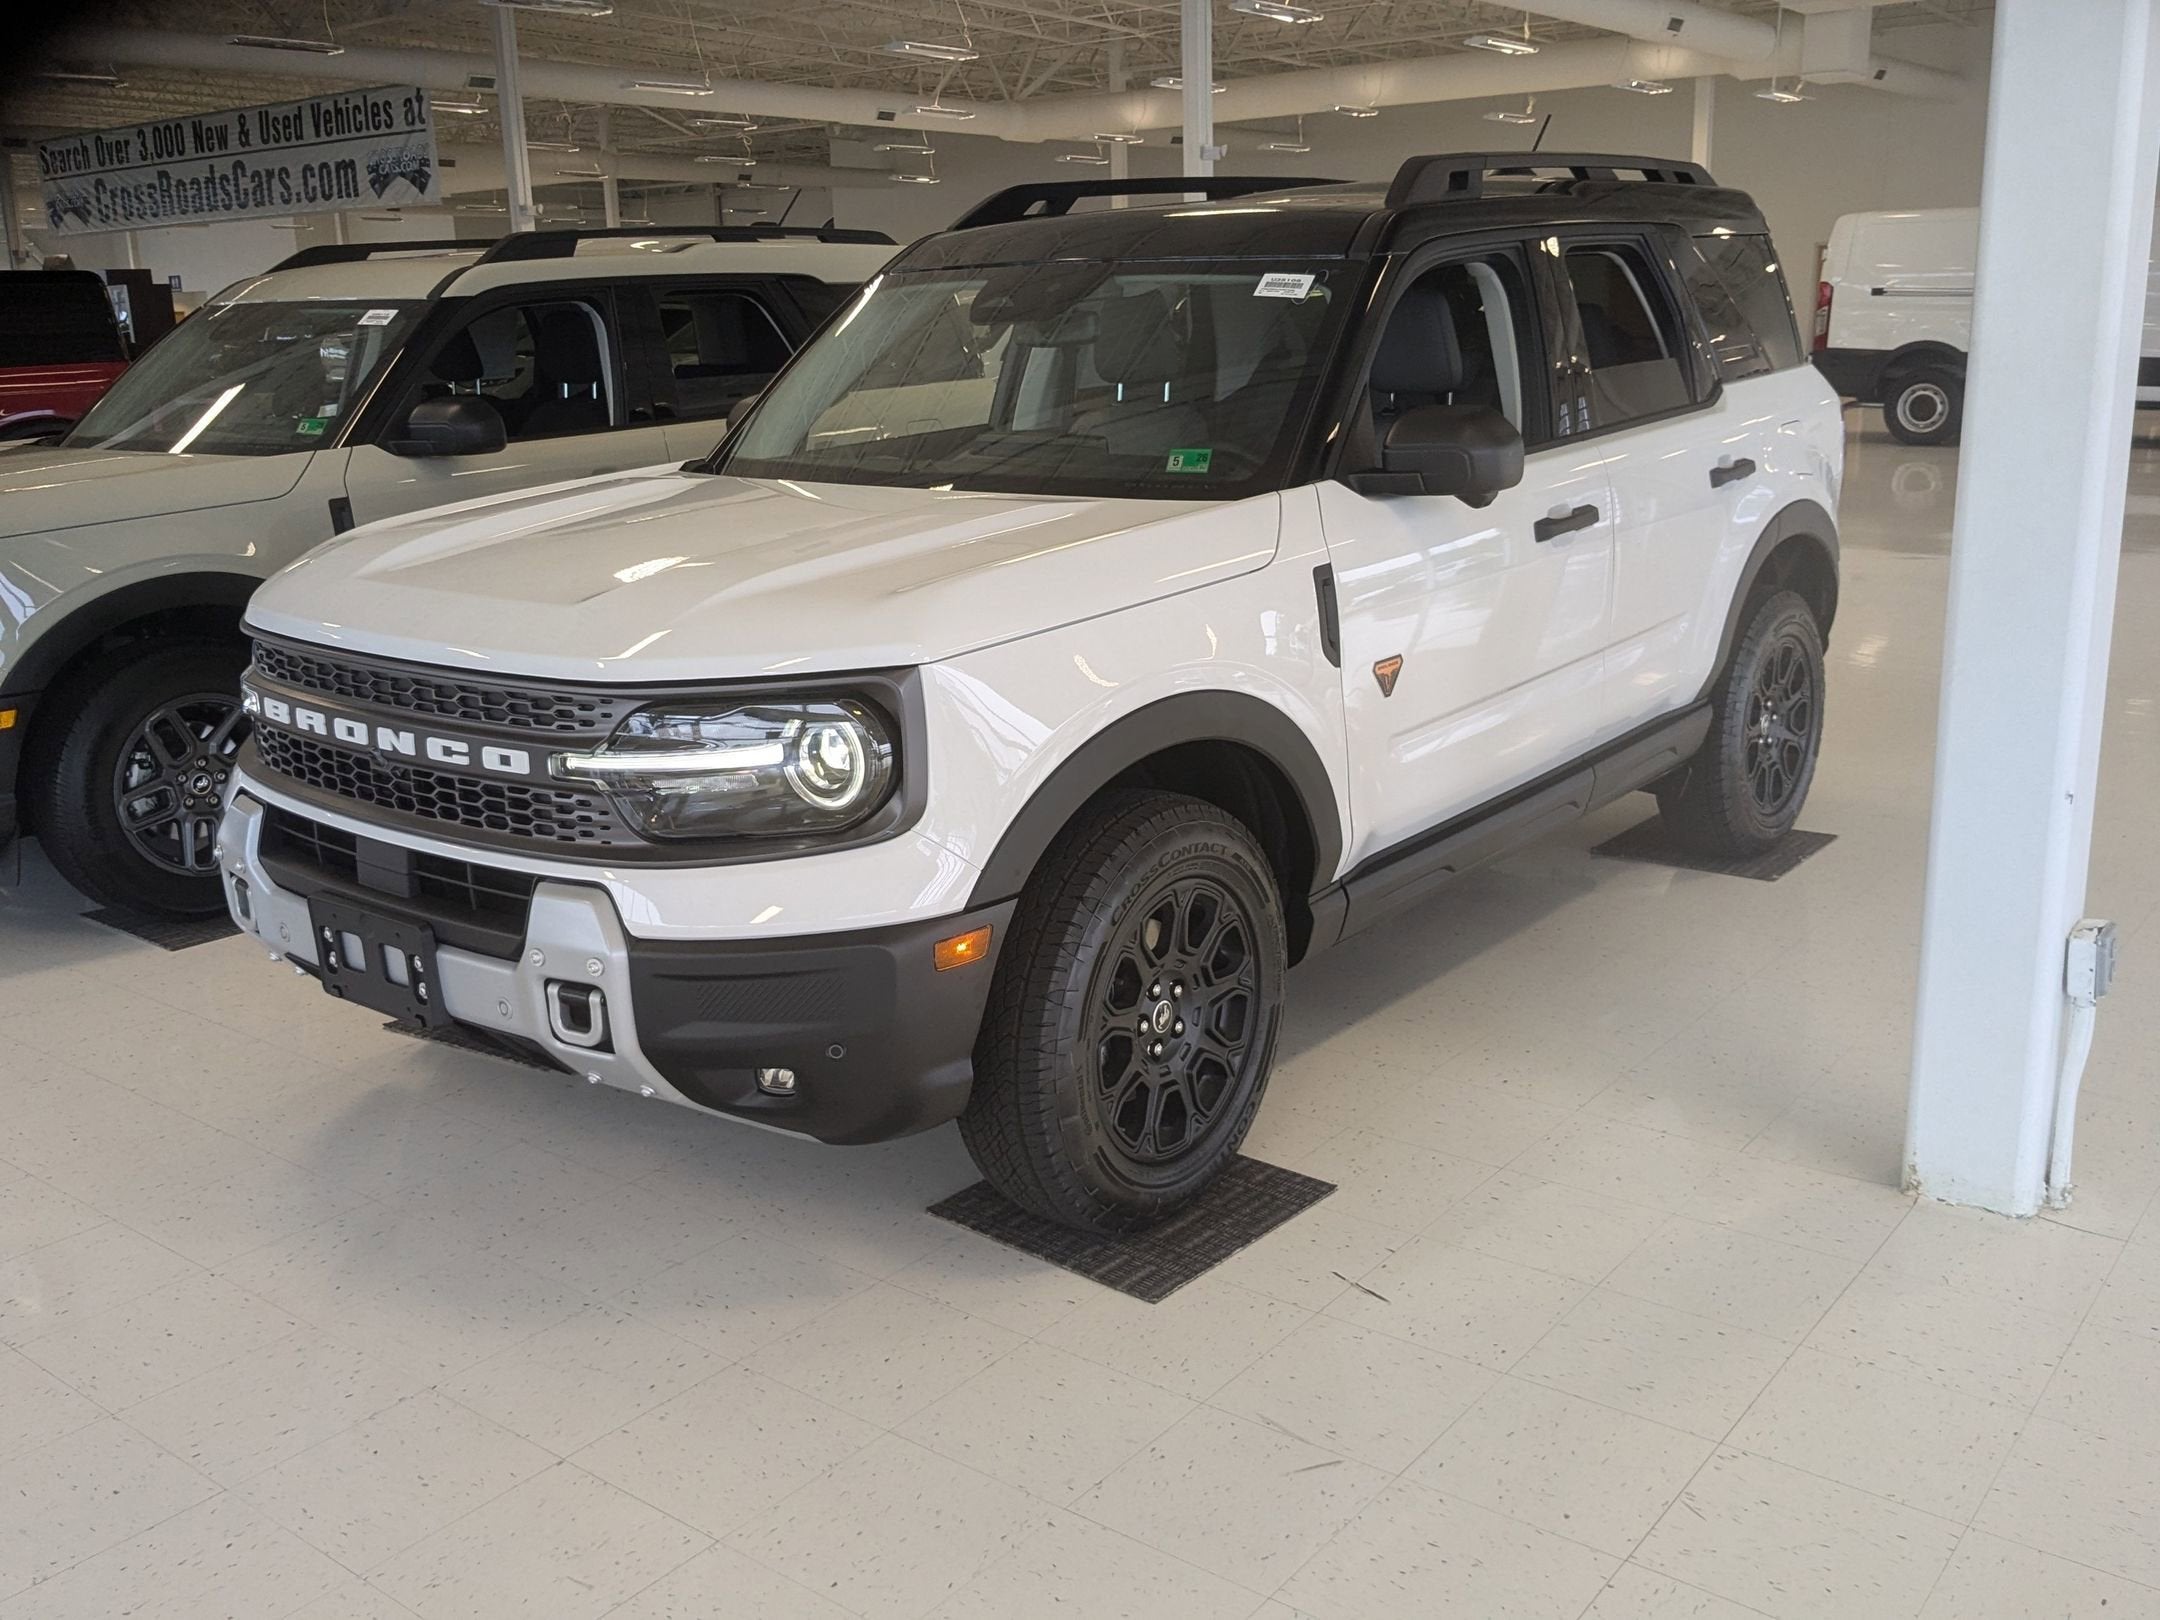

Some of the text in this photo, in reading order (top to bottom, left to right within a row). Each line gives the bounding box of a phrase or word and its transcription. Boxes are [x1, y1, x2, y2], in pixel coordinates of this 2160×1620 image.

[40, 87, 427, 175] Search Over 3,000 New & Used Vehicles at
[94, 158, 360, 224] CrossRoadsCars.com
[1172, 456, 1180, 467] 5
[263, 697, 531, 775] BRONCO
